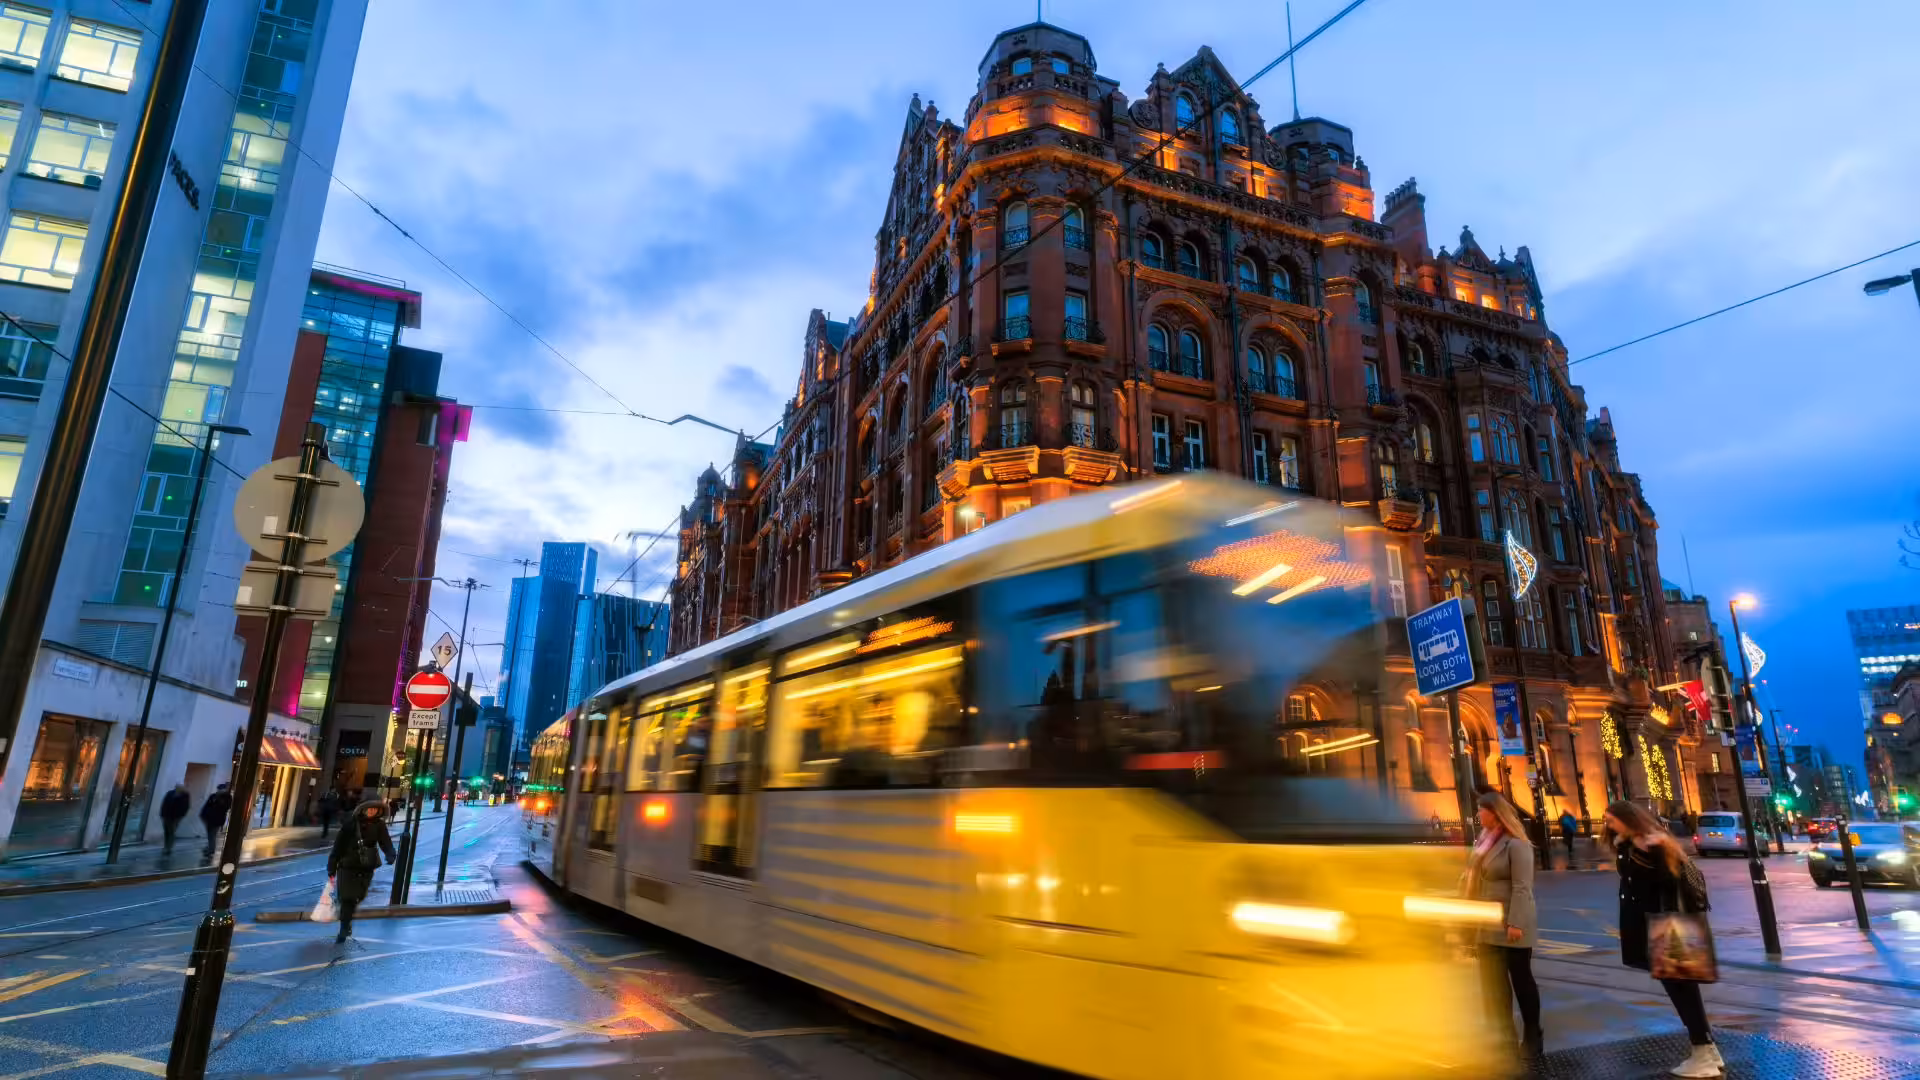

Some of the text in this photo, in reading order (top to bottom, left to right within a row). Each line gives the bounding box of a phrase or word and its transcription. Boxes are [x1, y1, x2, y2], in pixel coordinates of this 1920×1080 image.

[1413, 605, 1453, 630] TRAMWAY
[437, 645, 452, 656] 15
[1418, 652, 1467, 678] LOOK BOTH
[1432, 670, 1456, 686] WAYS
[411, 712, 437, 720] Except
